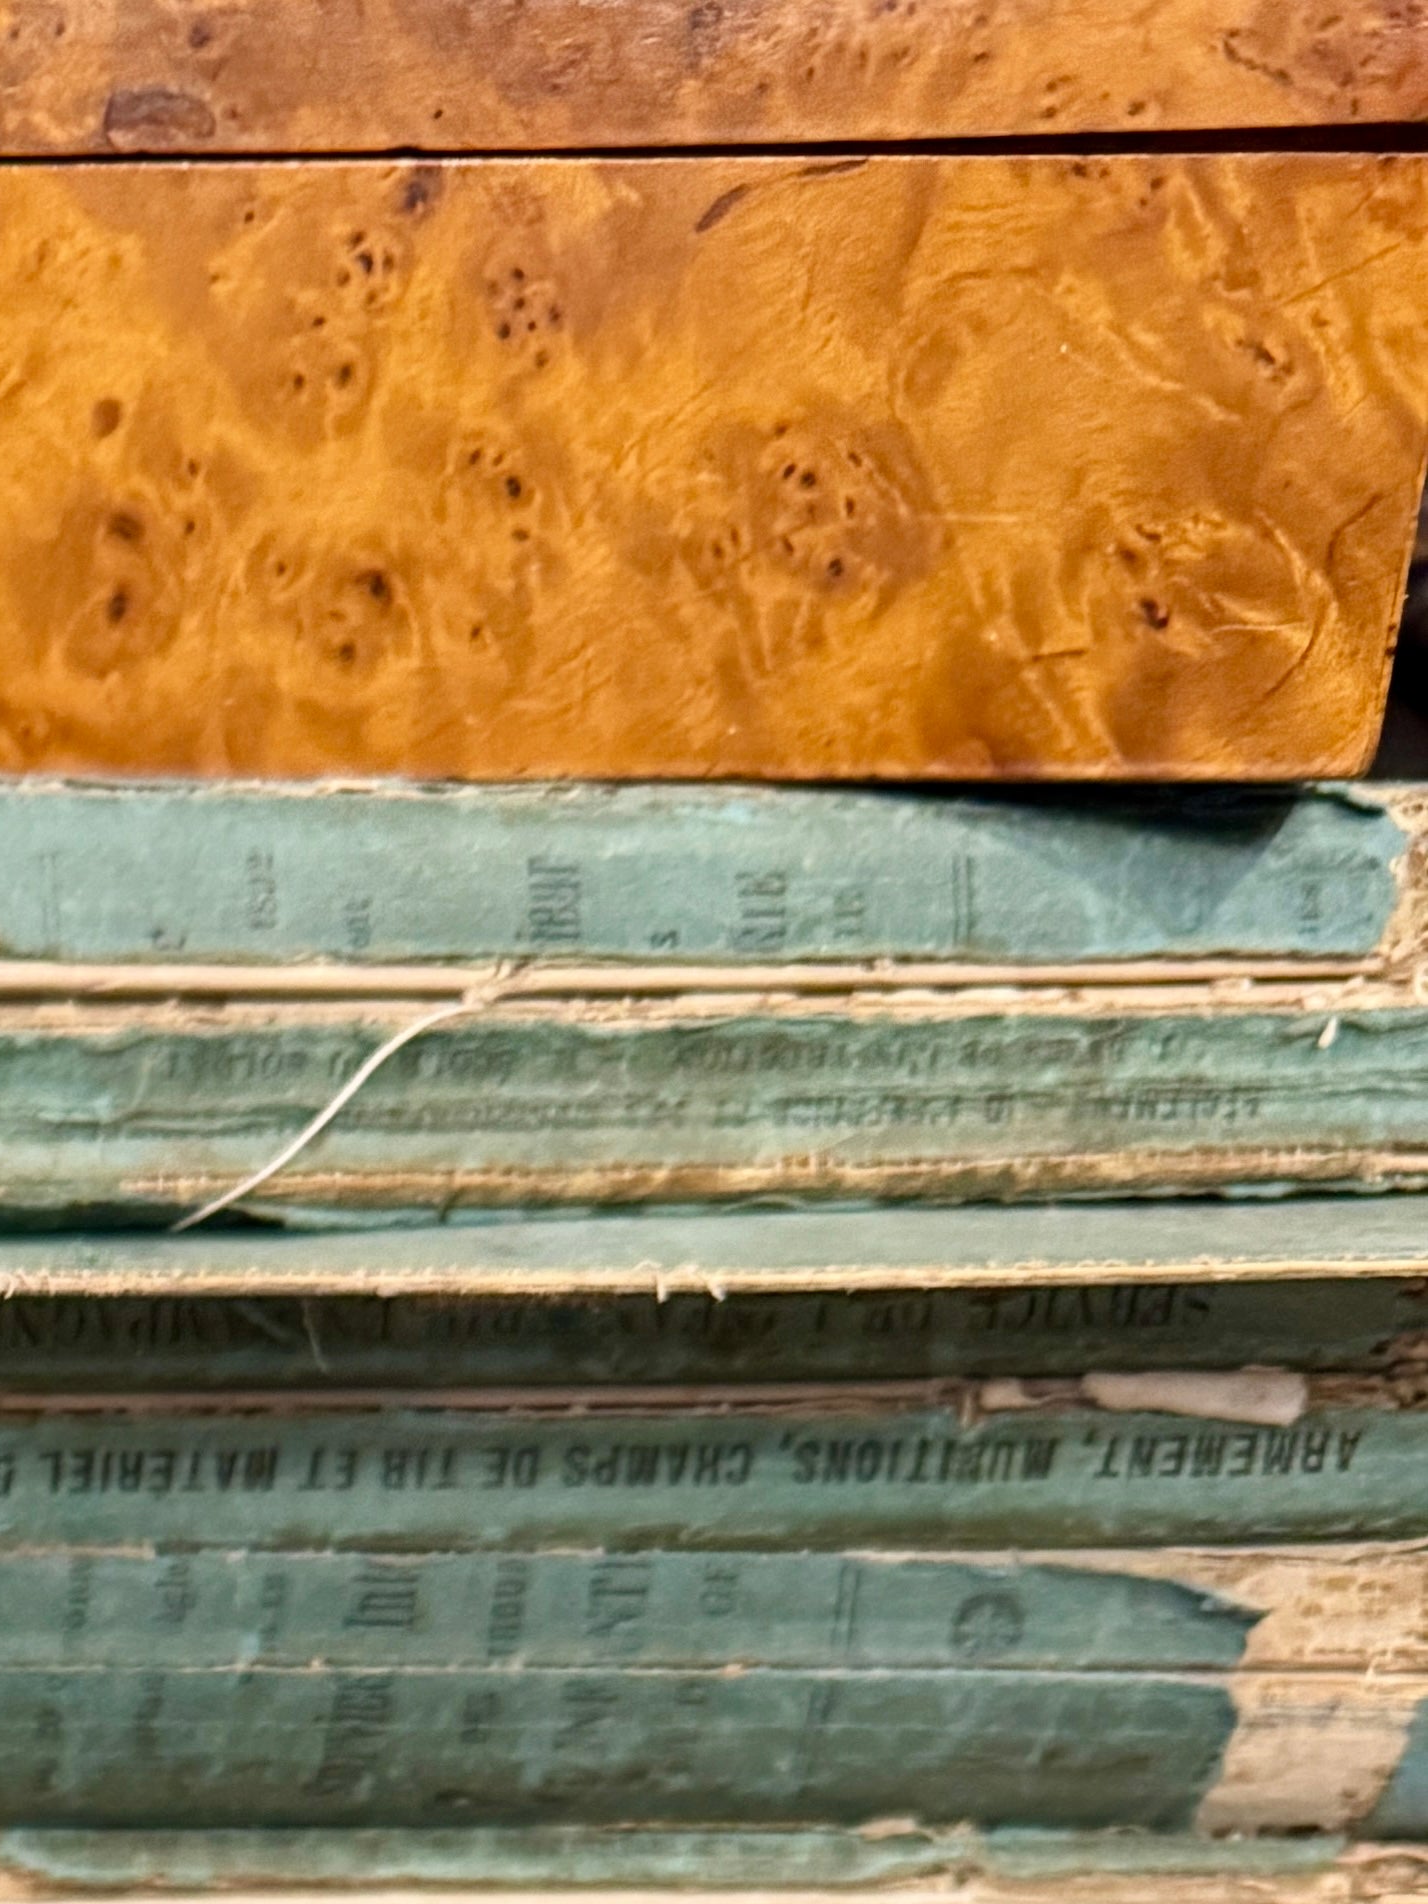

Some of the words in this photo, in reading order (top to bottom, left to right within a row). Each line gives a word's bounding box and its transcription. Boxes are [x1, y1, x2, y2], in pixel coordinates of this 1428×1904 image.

[965, 1283, 1219, 1331] SERVICE
[37, 1446, 279, 1504] MATÉRIEL
[295, 1448, 356, 1493] ET
[372, 1446, 460, 1491] TIR
[475, 1444, 540, 1490] DE
[557, 1441, 756, 1488] CHAMPS
[775, 1430, 1059, 1486] MUNITIONS,
[1081, 1426, 1364, 1481] ARMEMENT,
